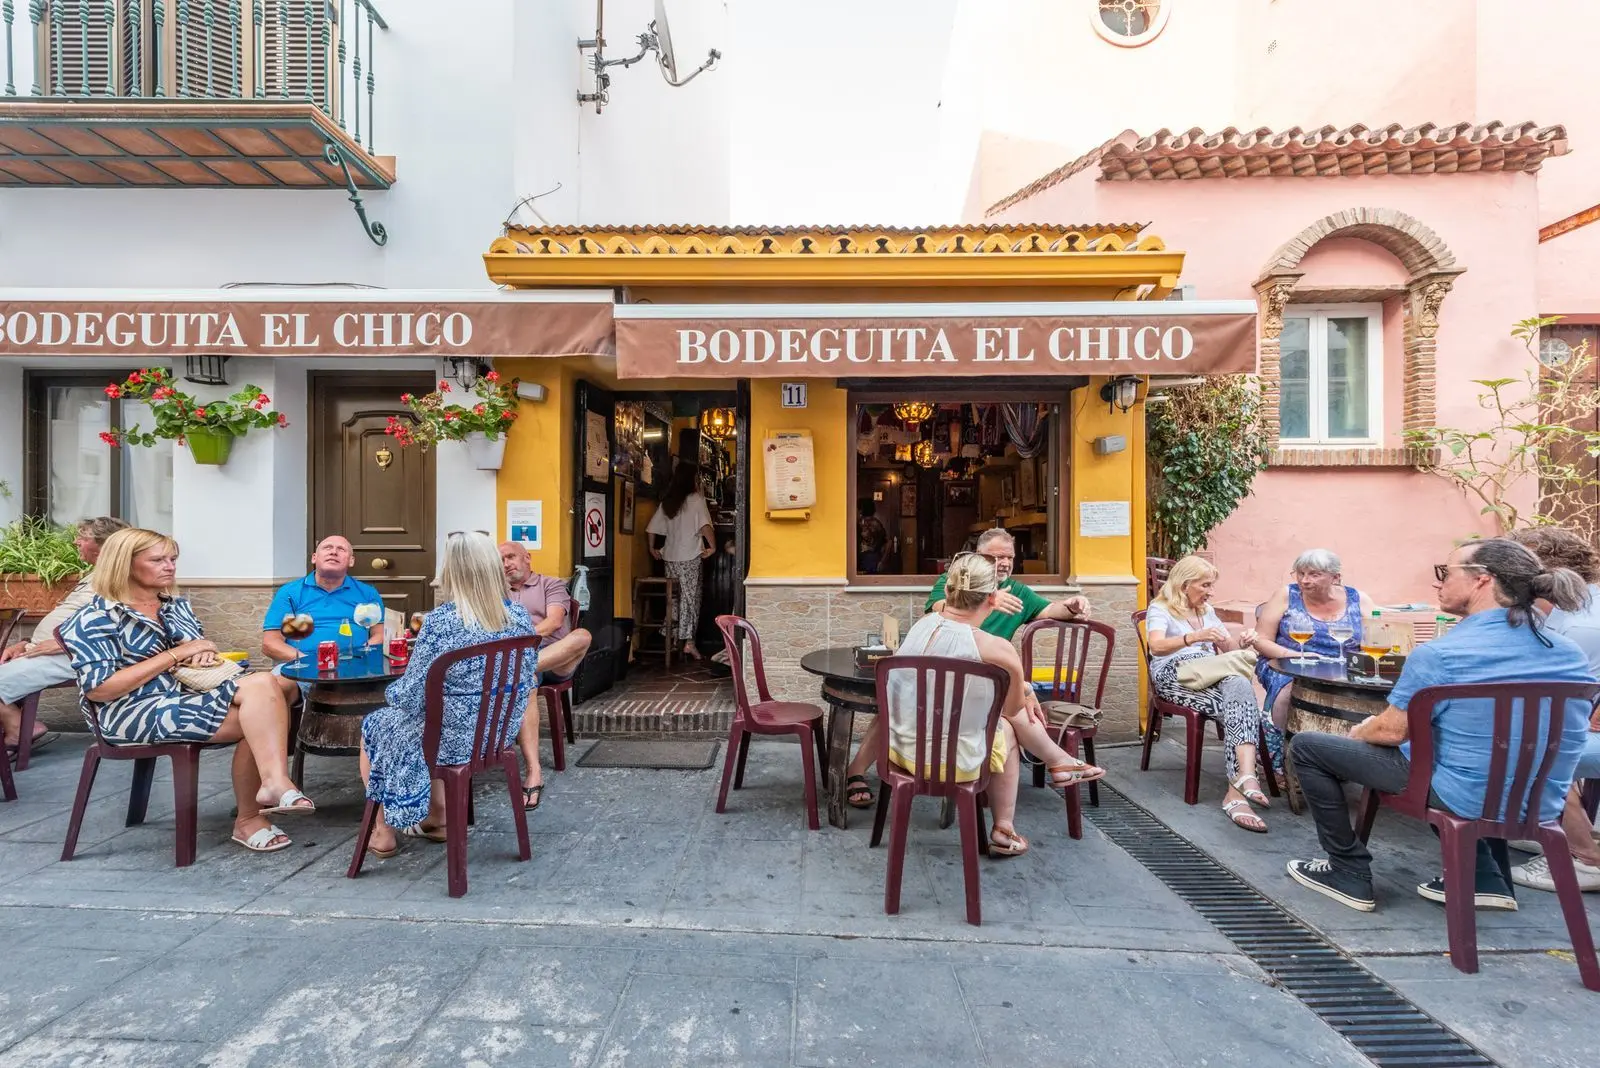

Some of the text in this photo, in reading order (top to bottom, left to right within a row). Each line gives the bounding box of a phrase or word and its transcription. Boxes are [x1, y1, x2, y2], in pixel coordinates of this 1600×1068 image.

[0, 311, 473, 347] ODEGUITA EL CHICO
[677, 325, 1194, 364] BODEGUITA EL CHICO
[787, 386, 802, 405] 11
